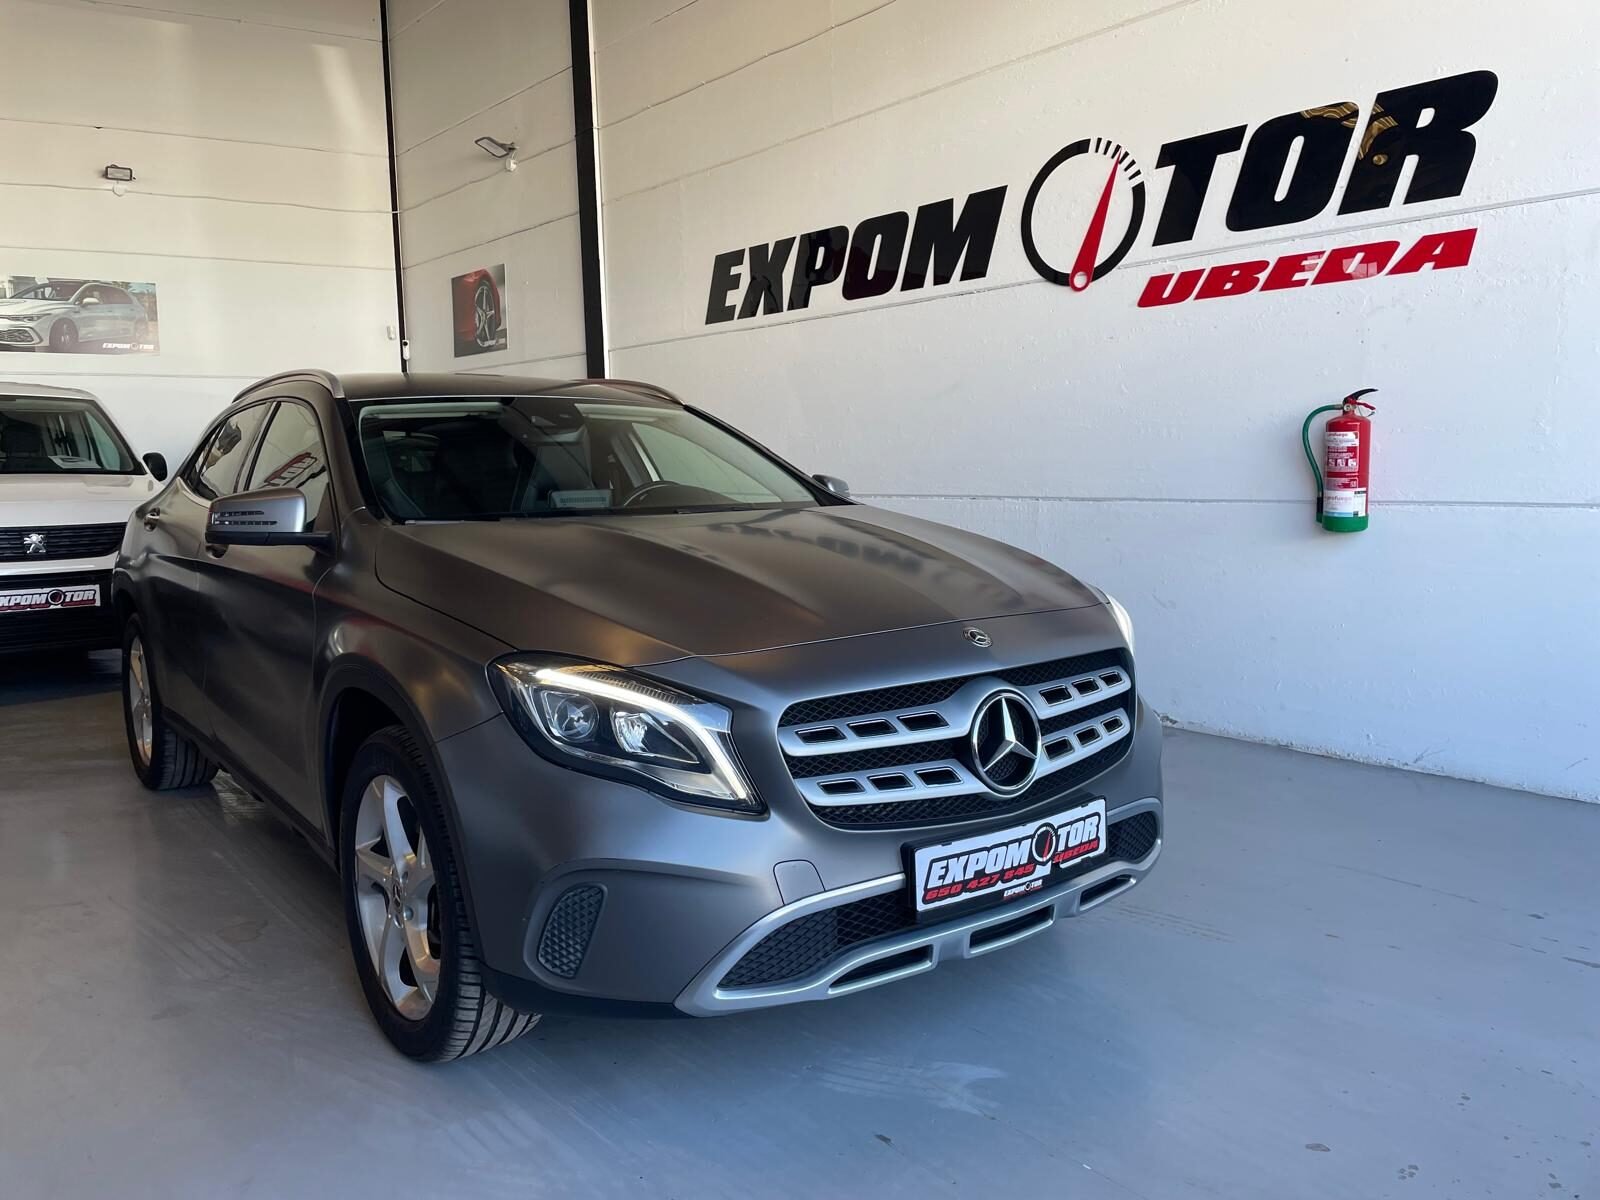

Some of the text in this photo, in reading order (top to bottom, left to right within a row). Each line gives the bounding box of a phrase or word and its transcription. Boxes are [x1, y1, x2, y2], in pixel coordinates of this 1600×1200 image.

[1137, 228, 1478, 308] UBEDA
[925, 883, 963, 900] 650
[966, 874, 1001, 889] 427
[926, 815, 1100, 889] EXPOMOTOR
